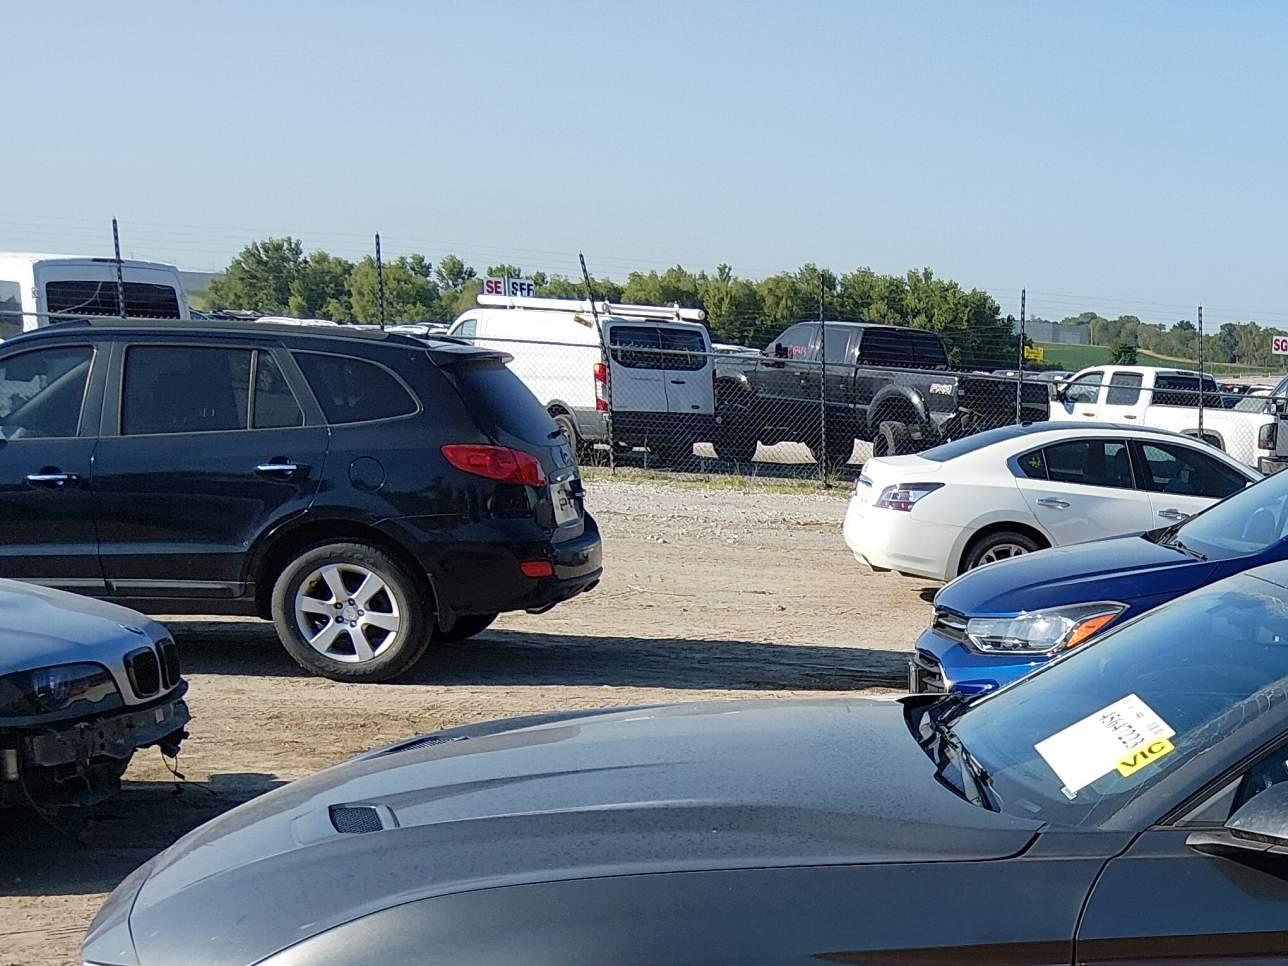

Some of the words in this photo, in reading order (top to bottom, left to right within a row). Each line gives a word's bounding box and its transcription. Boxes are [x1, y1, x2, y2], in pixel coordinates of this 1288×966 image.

[485, 279, 503, 295] SE
[1273, 338, 1288, 352] SG
[1120, 741, 1166, 768] VIC
